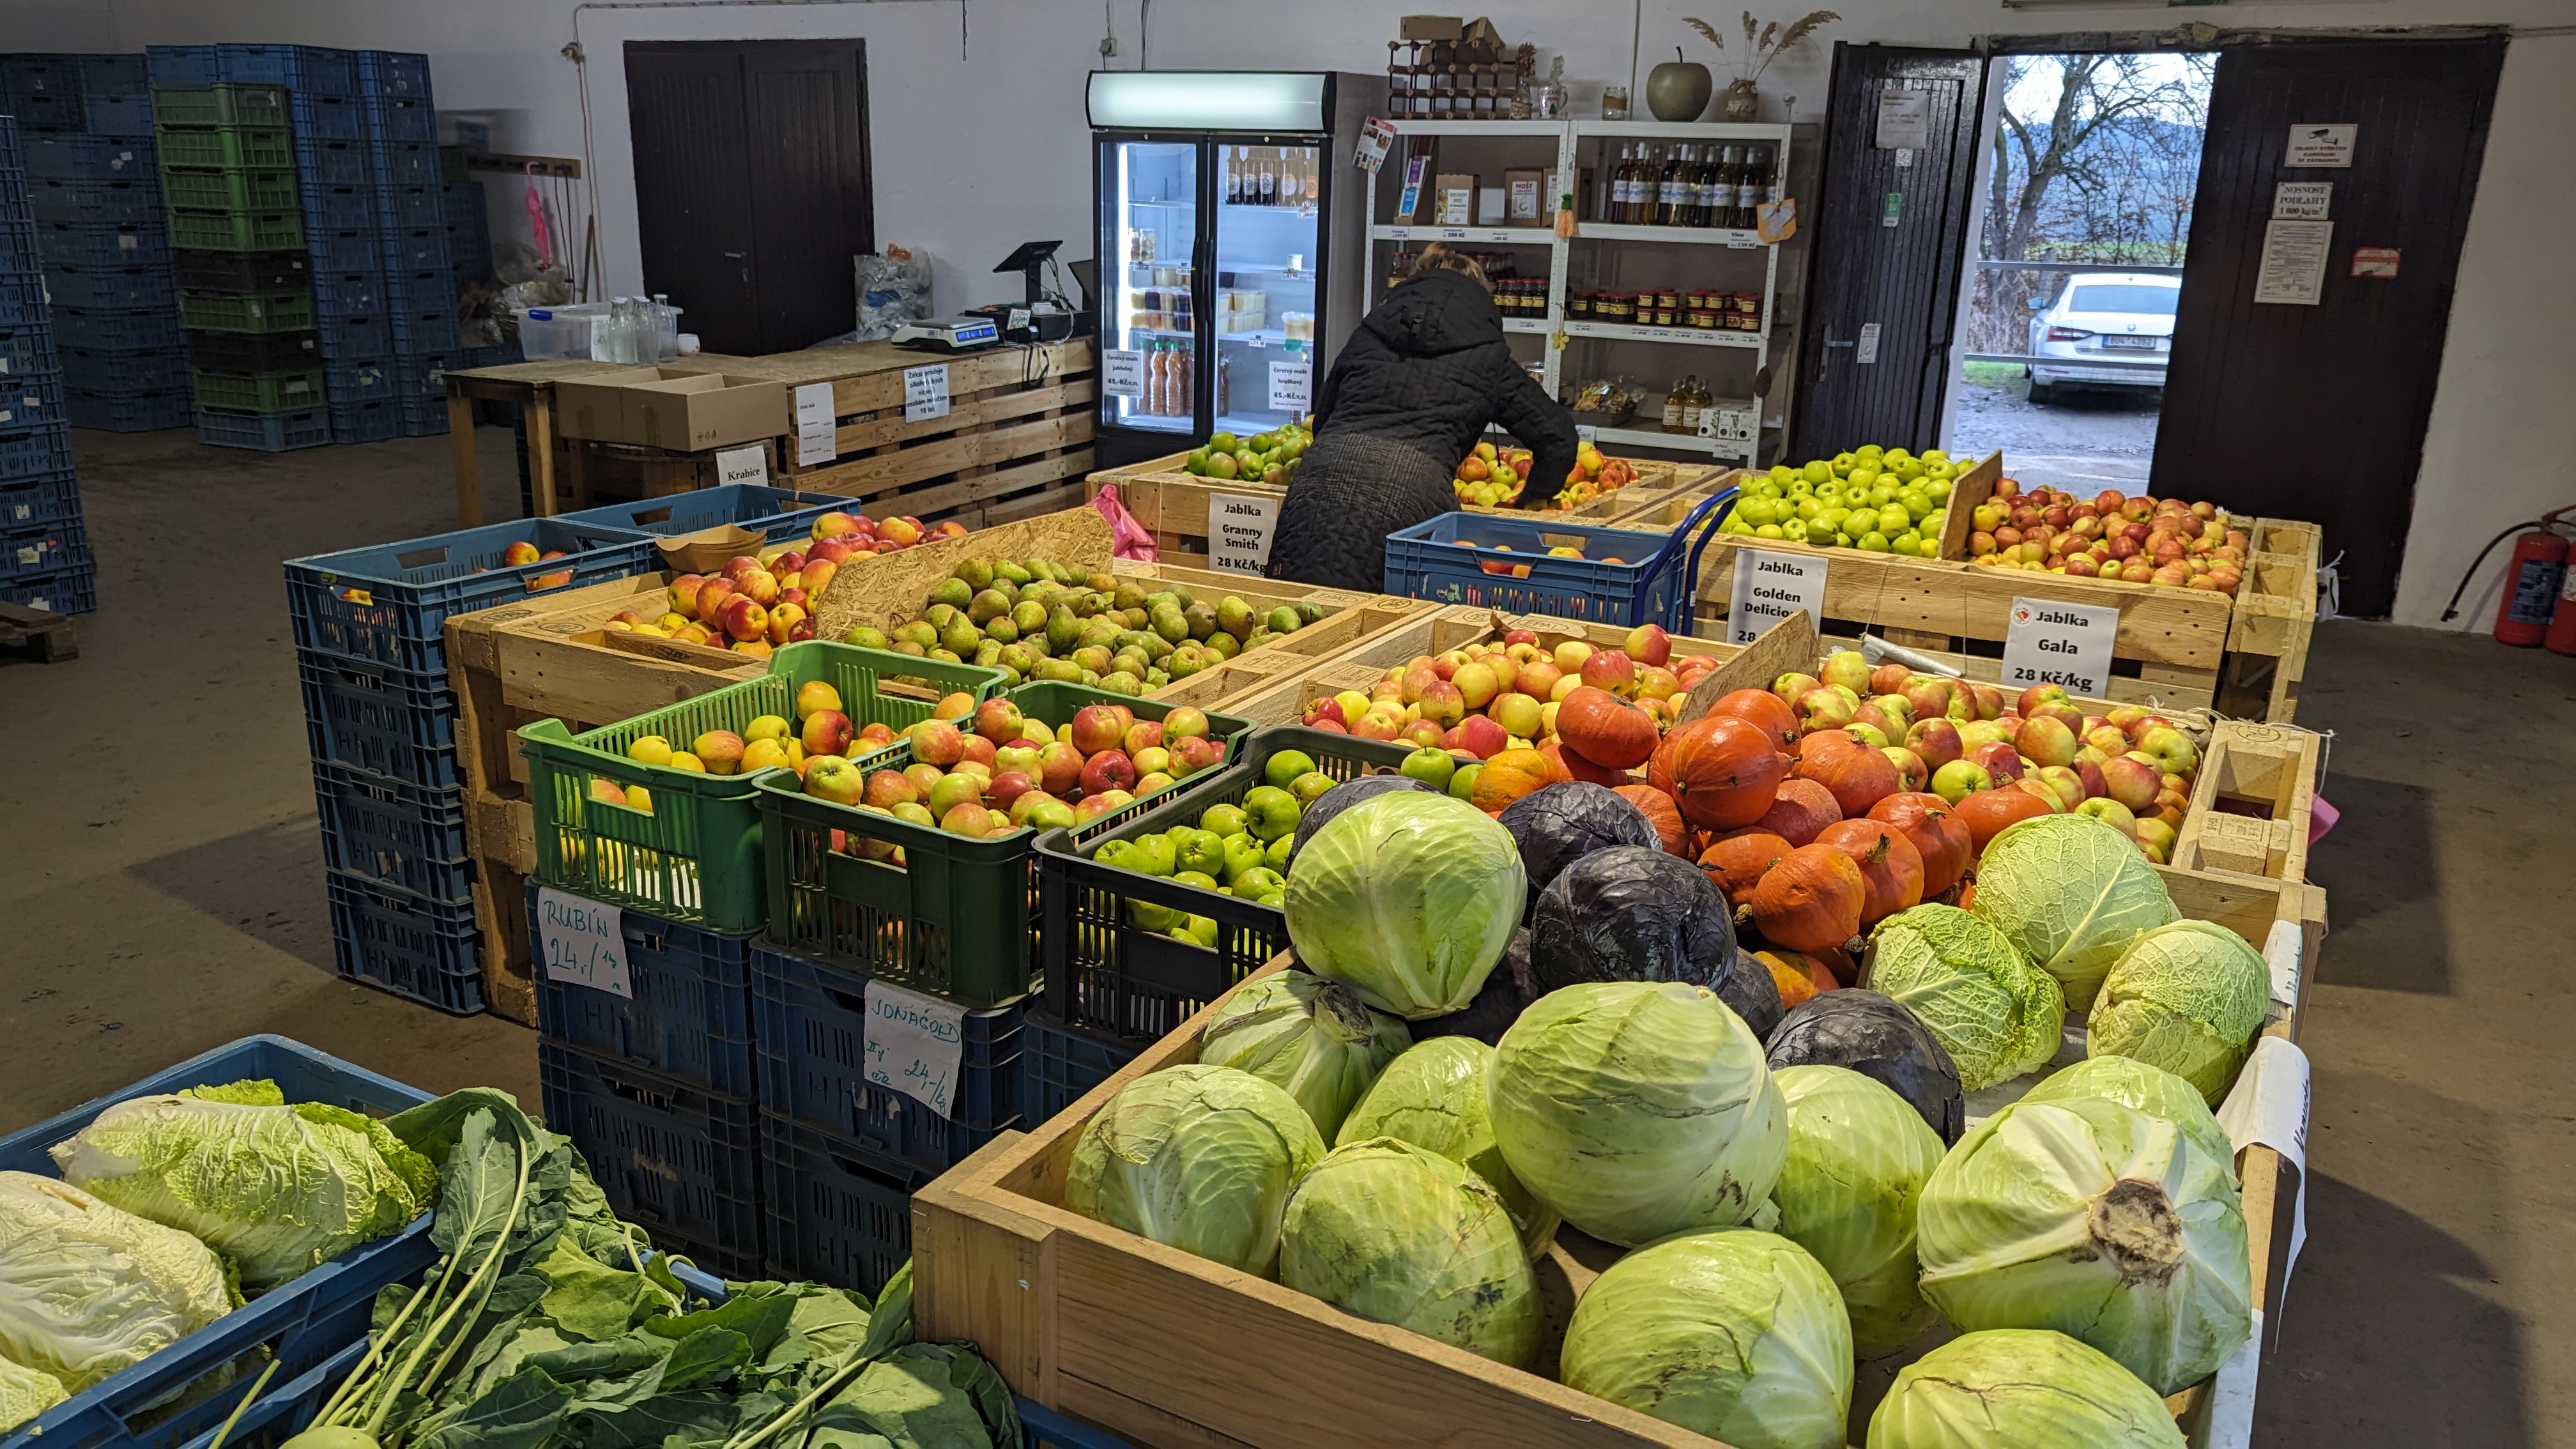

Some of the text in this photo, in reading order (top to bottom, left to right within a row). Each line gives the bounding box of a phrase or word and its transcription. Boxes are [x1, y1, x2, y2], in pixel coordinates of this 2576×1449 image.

[728, 468, 760, 480] Krabice
[1225, 503, 1261, 516] Jablka
[1222, 524, 1262, 539] Granny
[1225, 538, 1259, 550] Smith
[1217, 557, 1266, 575] 28 Kč/kg
[1758, 562, 1803, 576] Jablka
[1753, 587, 1801, 602] Golden
[1745, 603, 1793, 618] Delicio
[2036, 611, 2089, 627] Jablka
[1738, 631, 1756, 642] 28
[2038, 639, 2078, 654] Gala
[2014, 668, 2093, 693] 28 Kč/kg
[544, 900, 608, 937] RUBÍN
